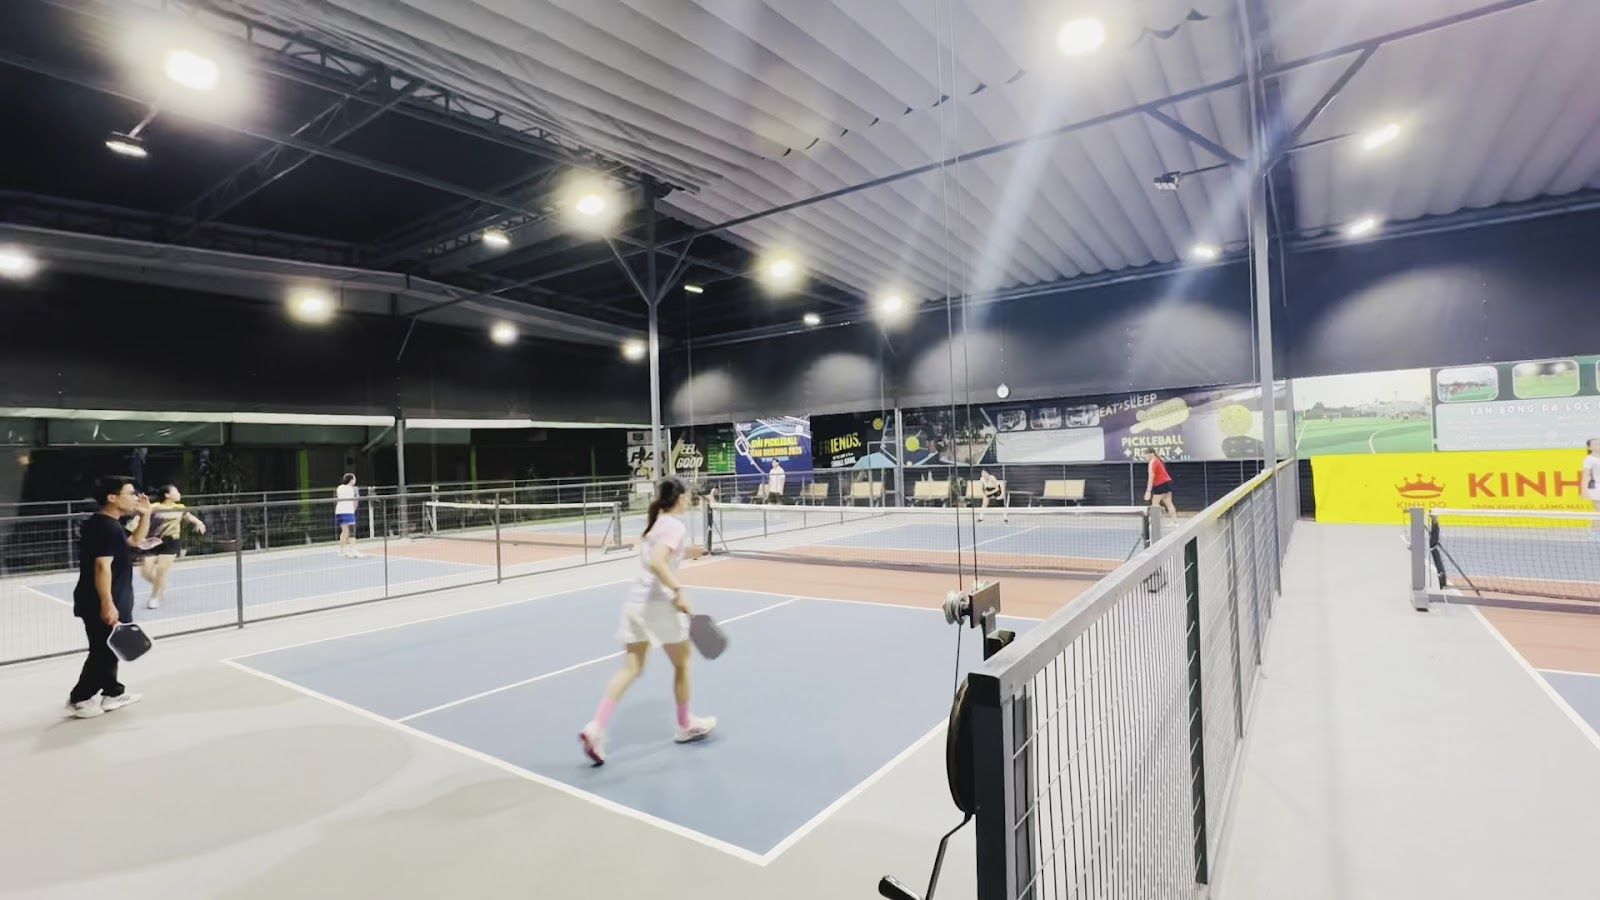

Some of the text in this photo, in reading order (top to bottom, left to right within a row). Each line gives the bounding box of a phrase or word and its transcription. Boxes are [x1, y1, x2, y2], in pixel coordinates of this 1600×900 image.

[1099, 393, 1158, 418] EAT SLEEP
[1121, 434, 1184, 447] PICKLEBALL
[676, 455, 704, 469] GOOD
[1468, 470, 1582, 498] KINH
